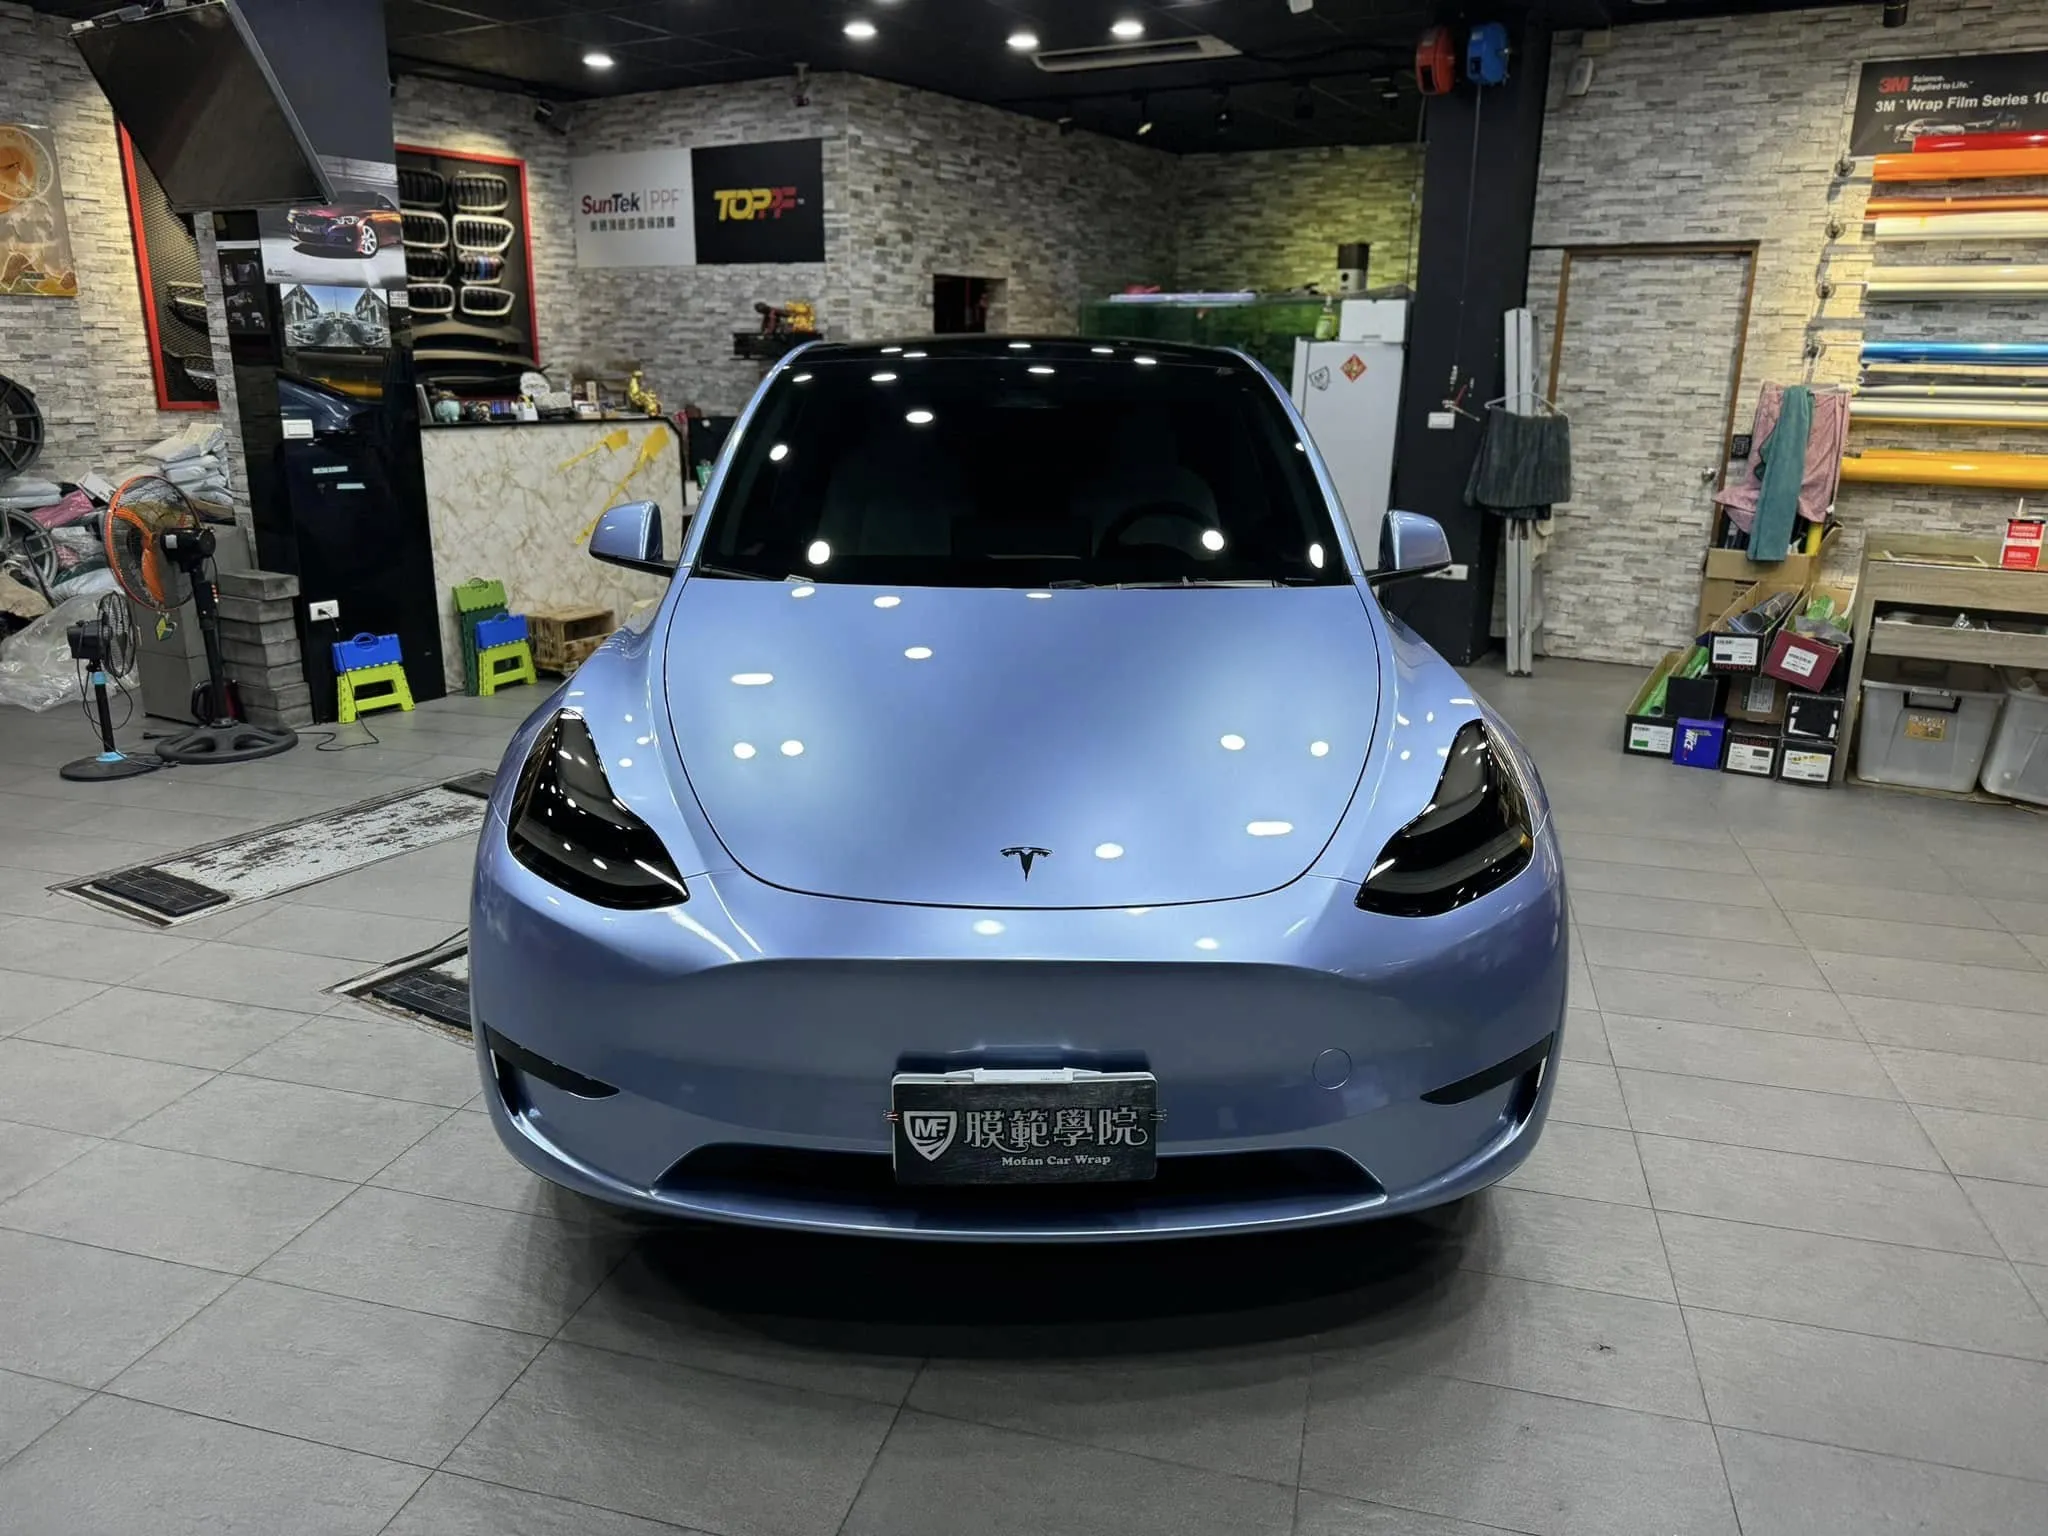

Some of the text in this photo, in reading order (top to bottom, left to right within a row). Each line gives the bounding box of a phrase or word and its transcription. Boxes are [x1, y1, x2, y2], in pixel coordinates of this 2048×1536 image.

[1880, 77, 1910, 92] 3M
[1911, 83, 1941, 91] Applied
[1907, 99, 1943, 112] Wrap
[1947, 96, 1978, 109] Film
[1982, 93, 2029, 107] Series
[581, 189, 678, 215] SunTek PPF
[964, 1109, 1148, 1152] 膜範學院
[1001, 1154, 1111, 1166] Mofan Car Wrap
